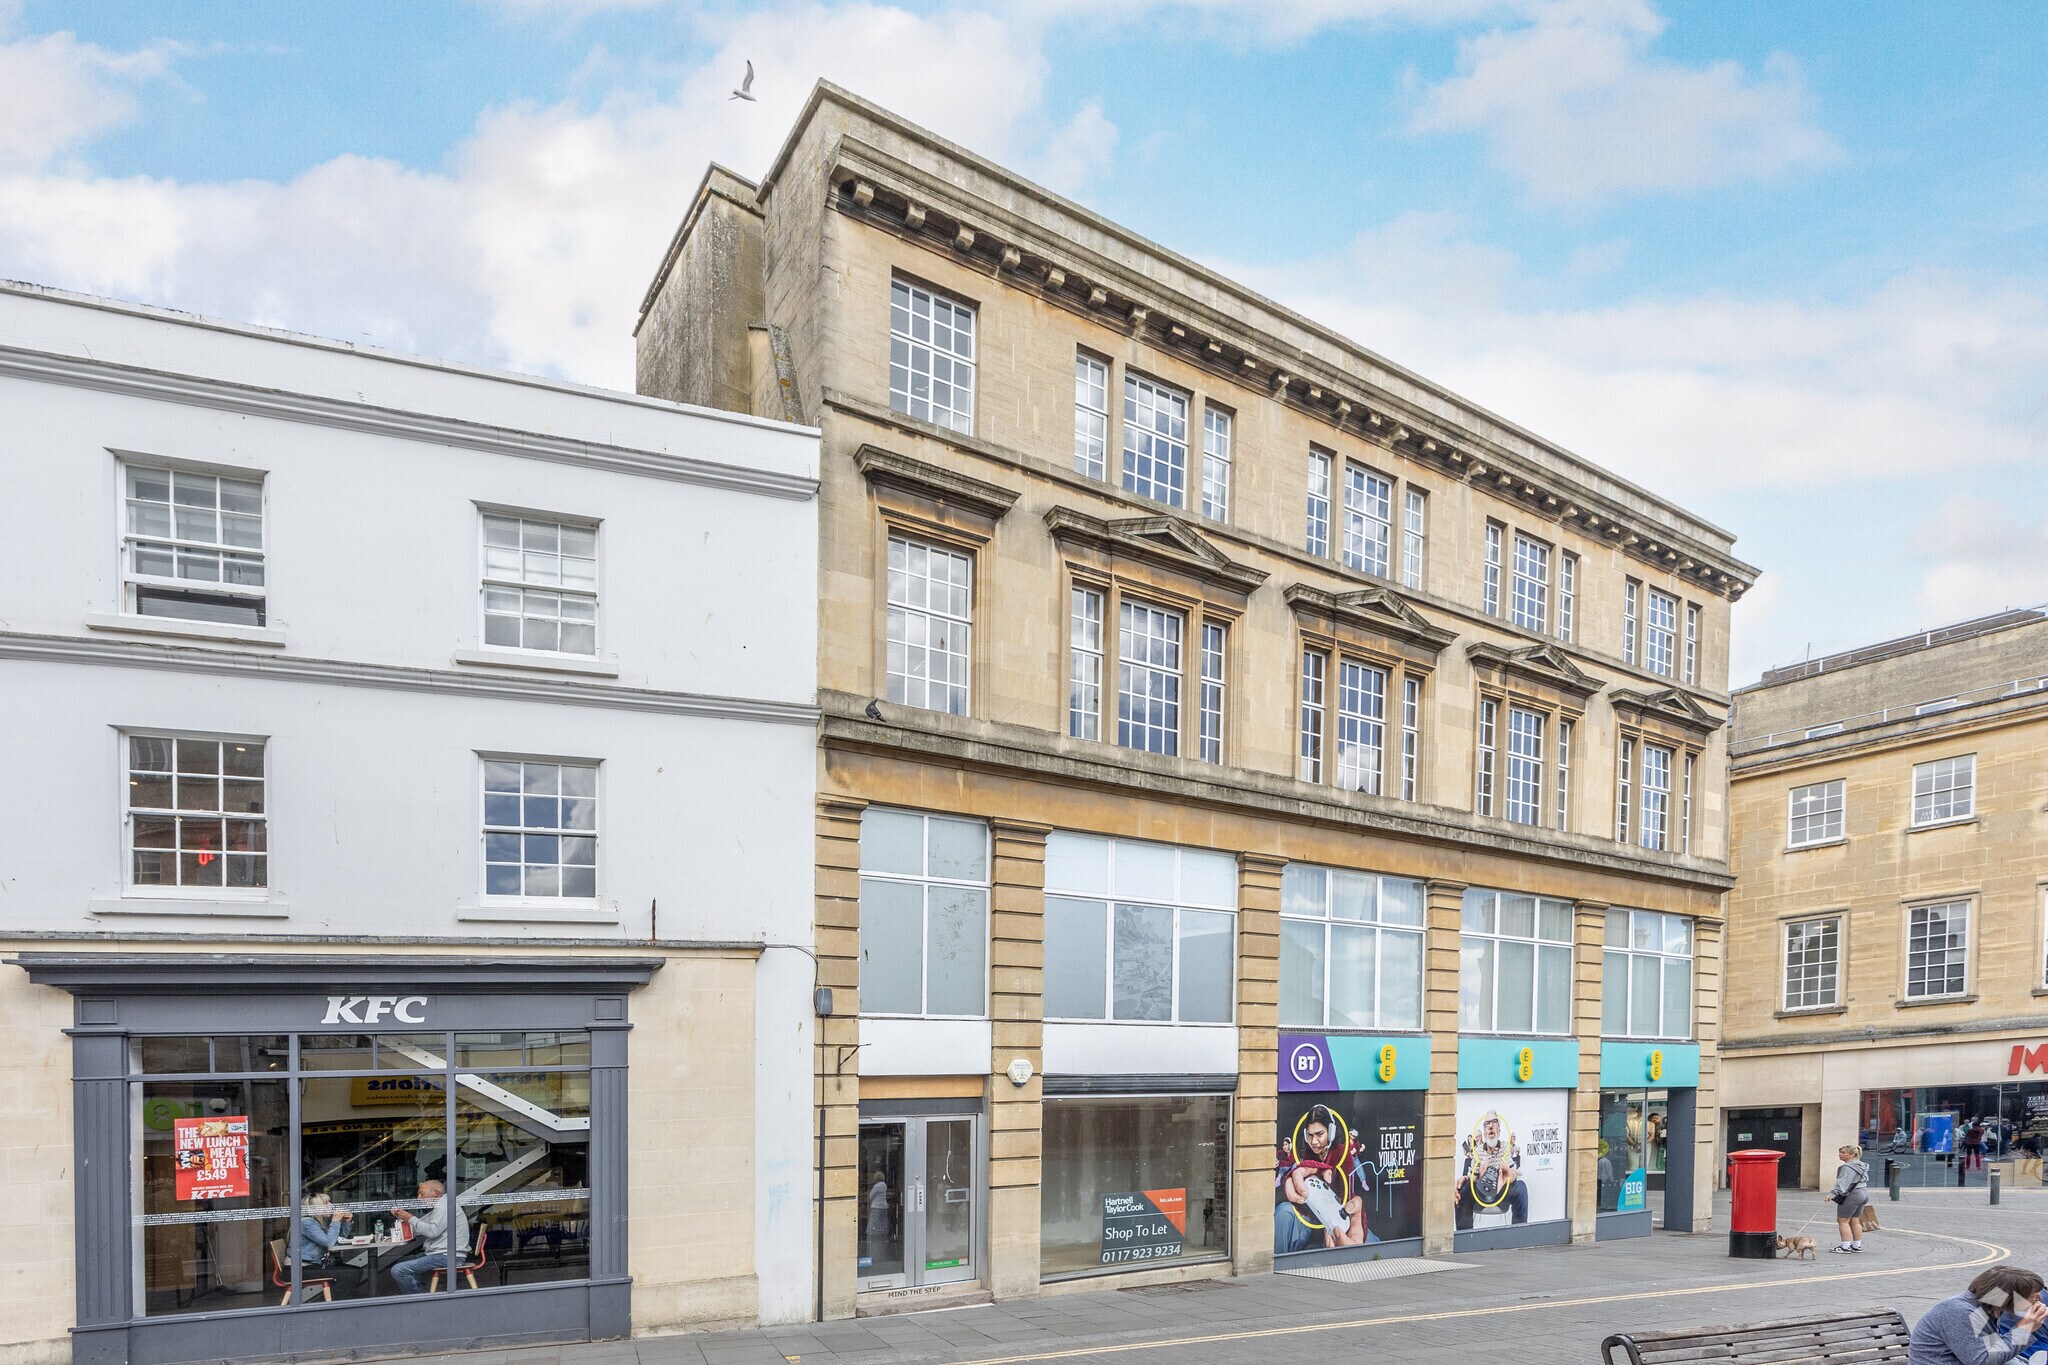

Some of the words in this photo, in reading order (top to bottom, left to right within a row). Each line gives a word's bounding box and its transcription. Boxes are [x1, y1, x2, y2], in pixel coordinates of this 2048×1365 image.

[321, 997, 428, 1024] KFC
[1298, 1056, 1316, 1071] BT
[178, 1127, 199, 1139] THE
[1532, 1128, 1545, 1142] YOUR
[1545, 1127, 1559, 1141] HOME
[180, 1137, 204, 1149] NEW
[206, 1135, 240, 1148] LUNCH
[1381, 1133, 1403, 1150] LEVEL
[1404, 1132, 1414, 1149] UP
[210, 1146, 238, 1159] MEAL
[1526, 1143, 1540, 1156] RUNS
[1541, 1141, 1563, 1155] SMARTER
[212, 1157, 239, 1170] DEAL
[1378, 1150, 1397, 1168] YOUR
[1398, 1149, 1416, 1166] PLAY
[197, 1168, 228, 1181] £5.49
[191, 1189, 233, 1200] KFC
[1625, 1181, 1643, 1195] BIG
[1105, 1196, 1134, 1206] Hartnell
[1105, 1227, 1133, 1241] Shop
[1136, 1224, 1149, 1237] To
[1151, 1223, 1168, 1236] Let
[1102, 1249, 1131, 1263] 0117
[1132, 1247, 1152, 1260] 923
[1154, 1244, 1181, 1257] 9234
[888, 1290, 908, 1298] MIND
[924, 1286, 941, 1294] STEP
